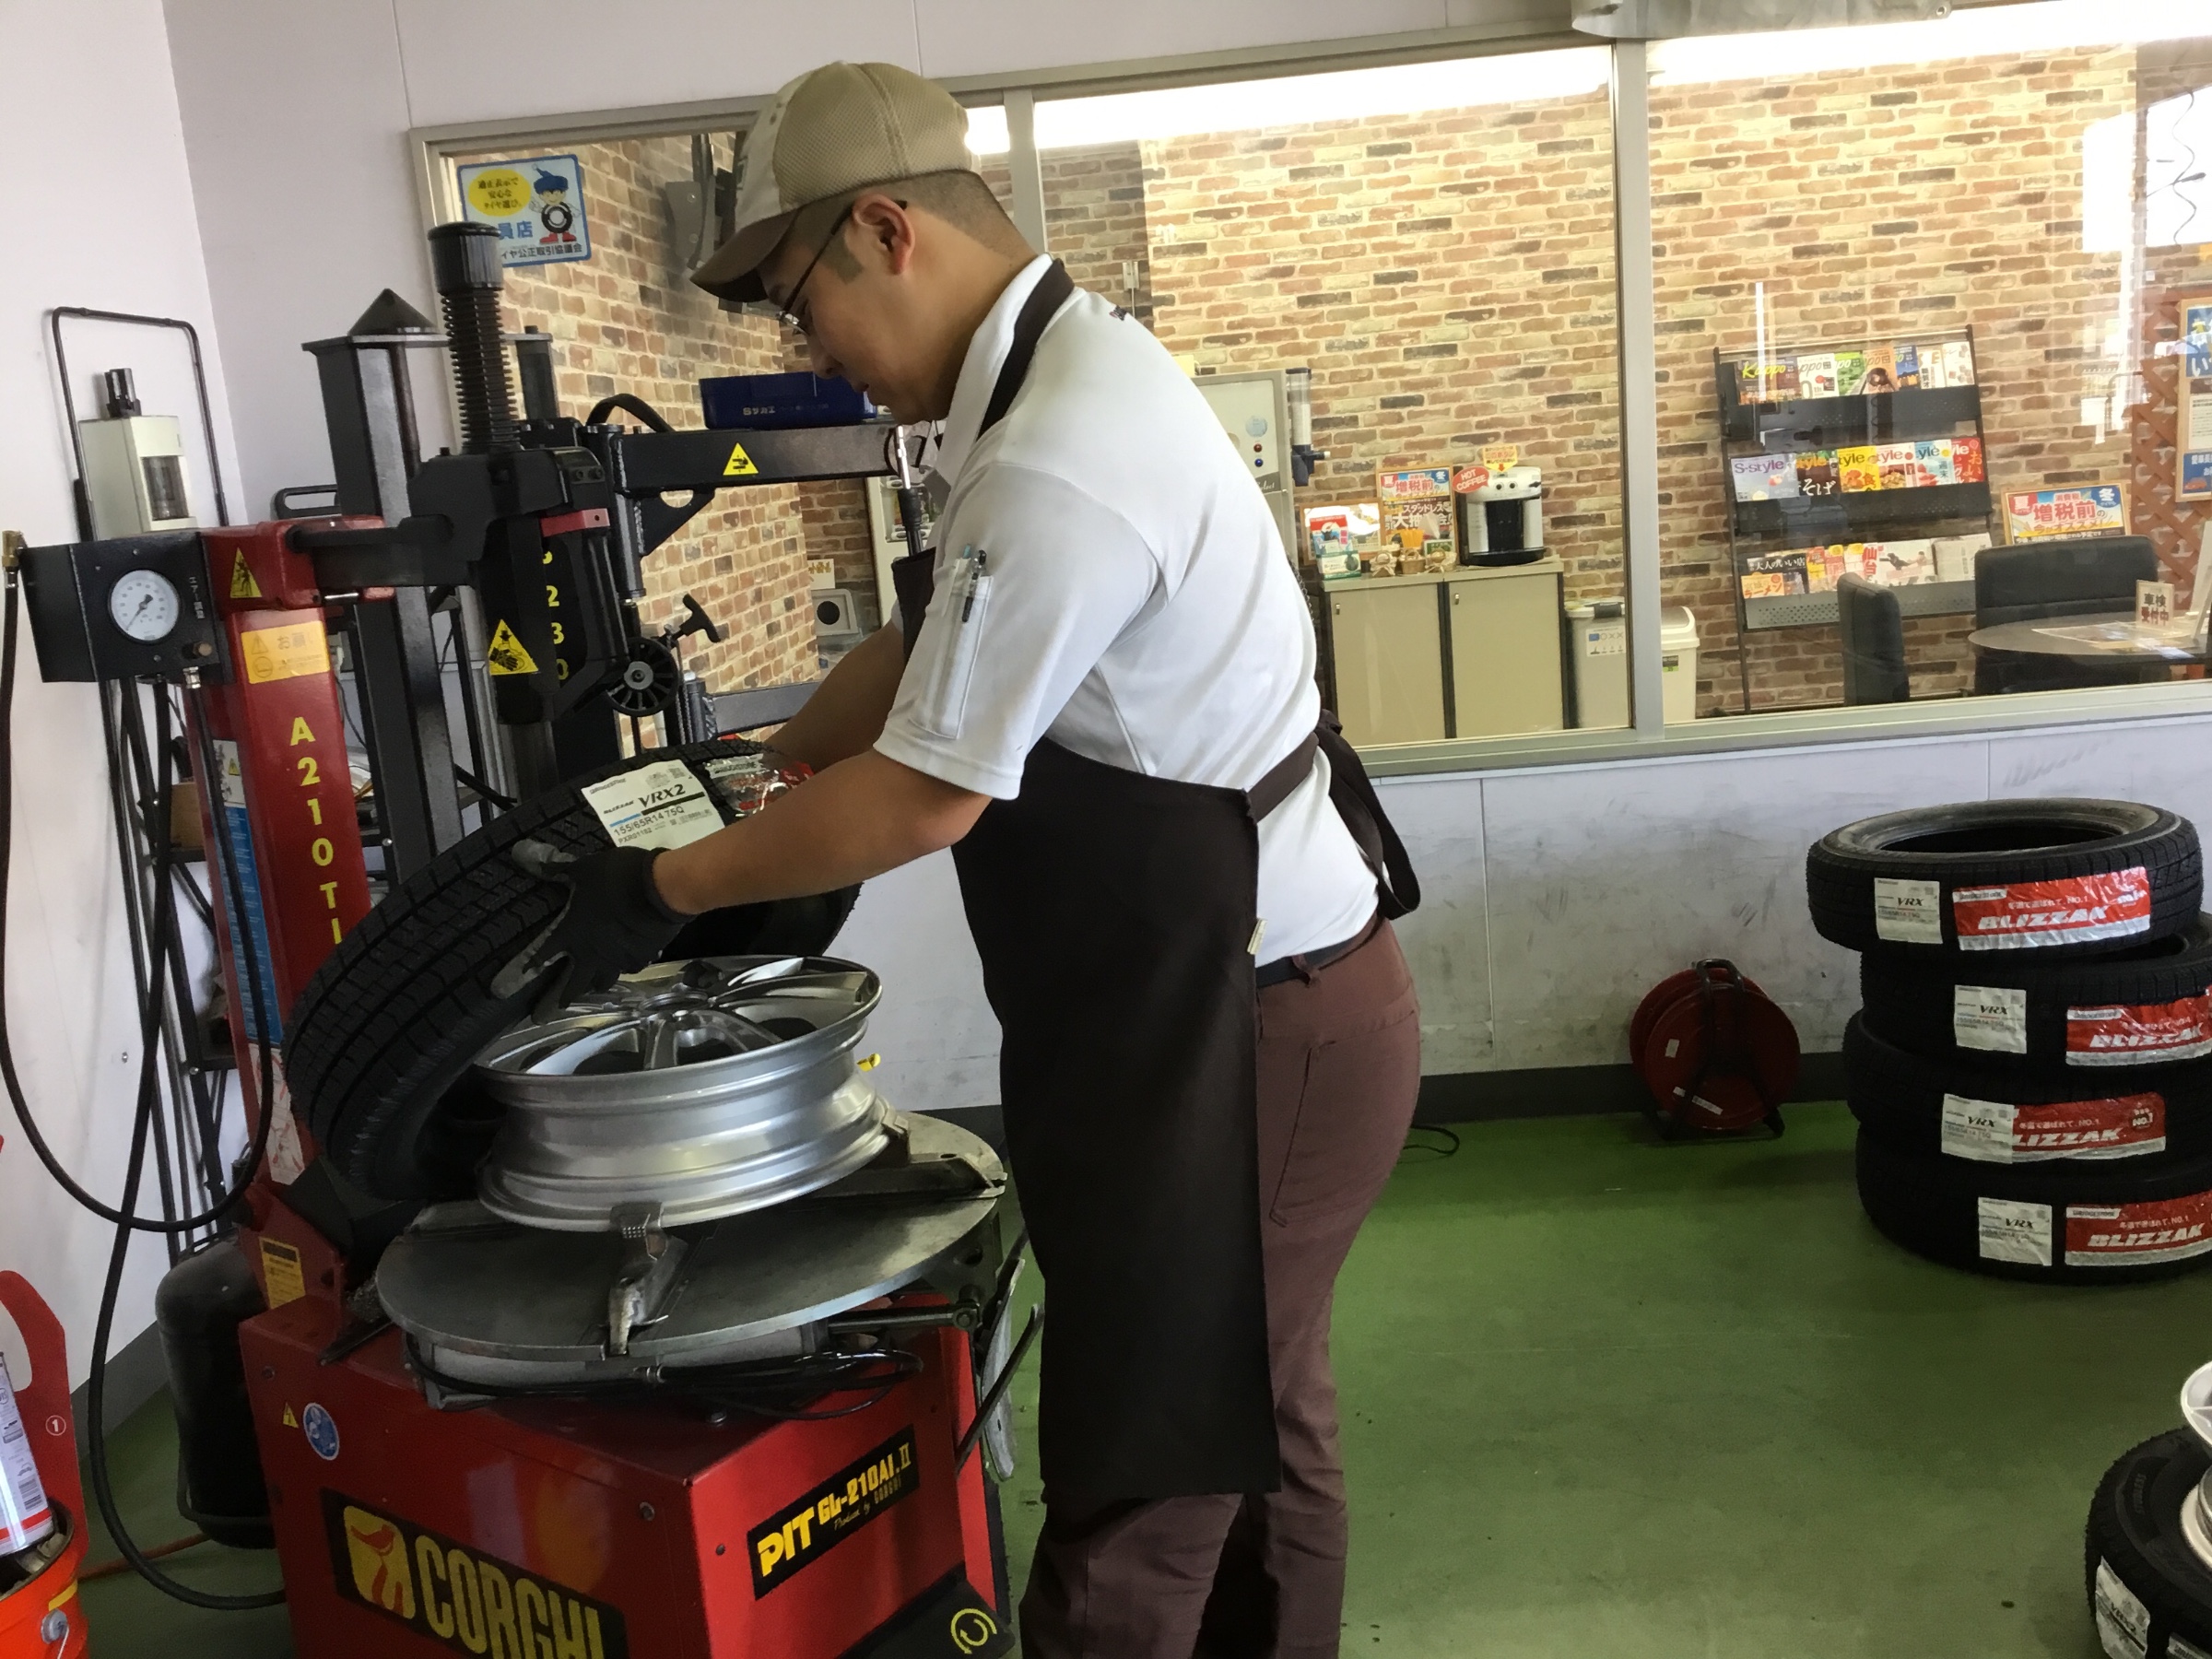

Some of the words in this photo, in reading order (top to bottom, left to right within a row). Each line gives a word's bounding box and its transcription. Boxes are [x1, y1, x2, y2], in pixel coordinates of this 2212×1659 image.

[1461, 469, 1477, 480] HOT
[1735, 460, 1784, 474] S-style
[1456, 474, 1486, 490] COFFEE
[2099, 488, 2114, 501] 冬
[2144, 593, 2167, 608] 車検
[638, 783, 686, 807] VRX2
[613, 812, 664, 836] 155/65R14
[665, 806, 685, 818] 75Q
[1897, 897, 1924, 906] VRX
[1978, 905, 2111, 930] BLIZZAK
[1981, 1005, 2009, 1015] VRX
[1968, 1116, 1996, 1127] VRX
[2012, 1127, 2124, 1147] LIZZAK
[2006, 1218, 2034, 1229] VRX
[2088, 1222, 2206, 1247] BLIZZAK
[758, 1506, 815, 1578] PIT
[415, 1535, 605, 1659] CORGHI
